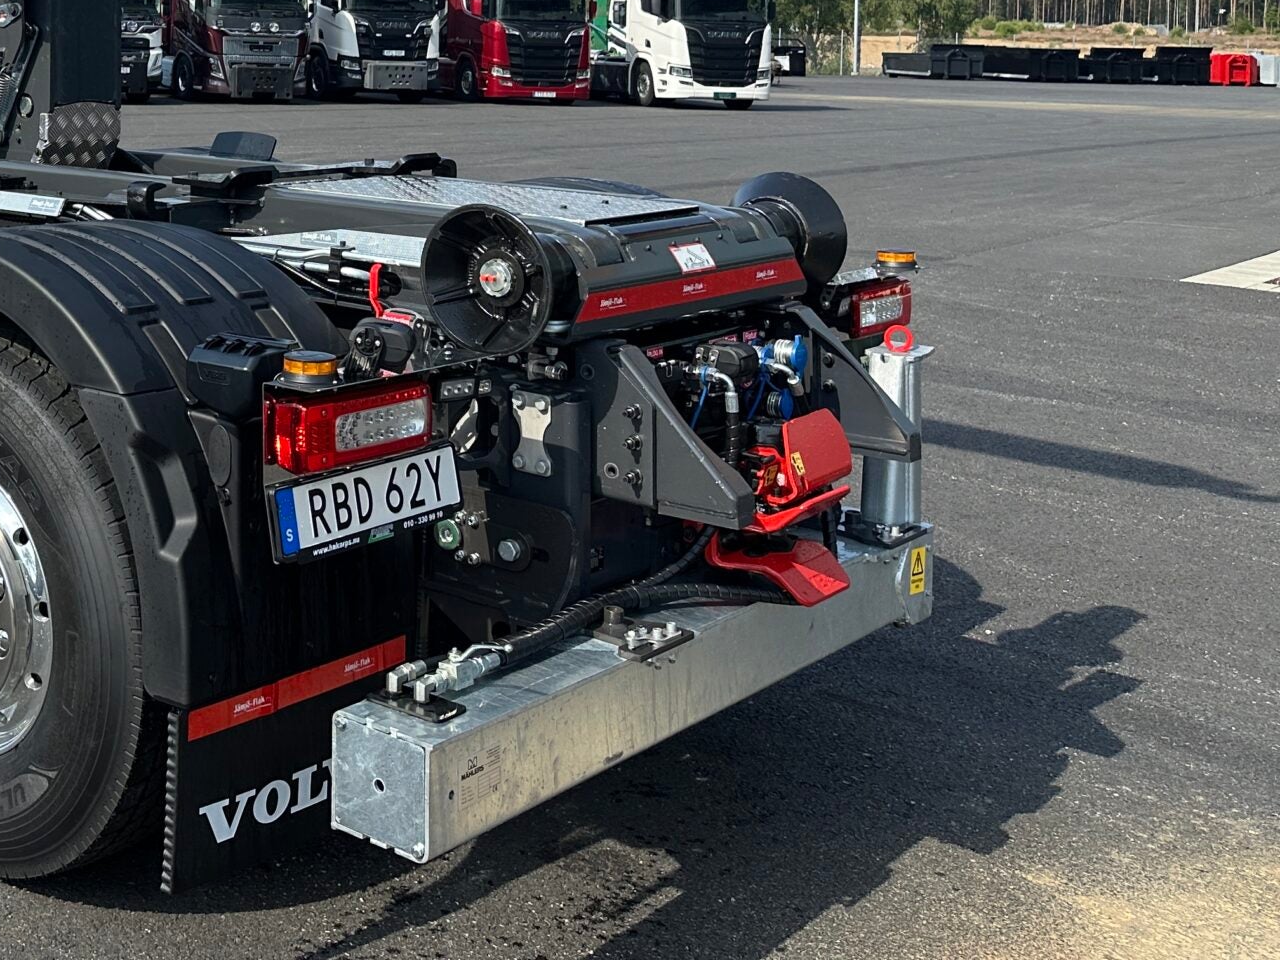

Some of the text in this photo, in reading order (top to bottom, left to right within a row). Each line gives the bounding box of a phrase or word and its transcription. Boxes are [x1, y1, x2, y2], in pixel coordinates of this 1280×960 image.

[308, 455, 441, 539] RBD 62Y
[285, 528, 294, 542] S
